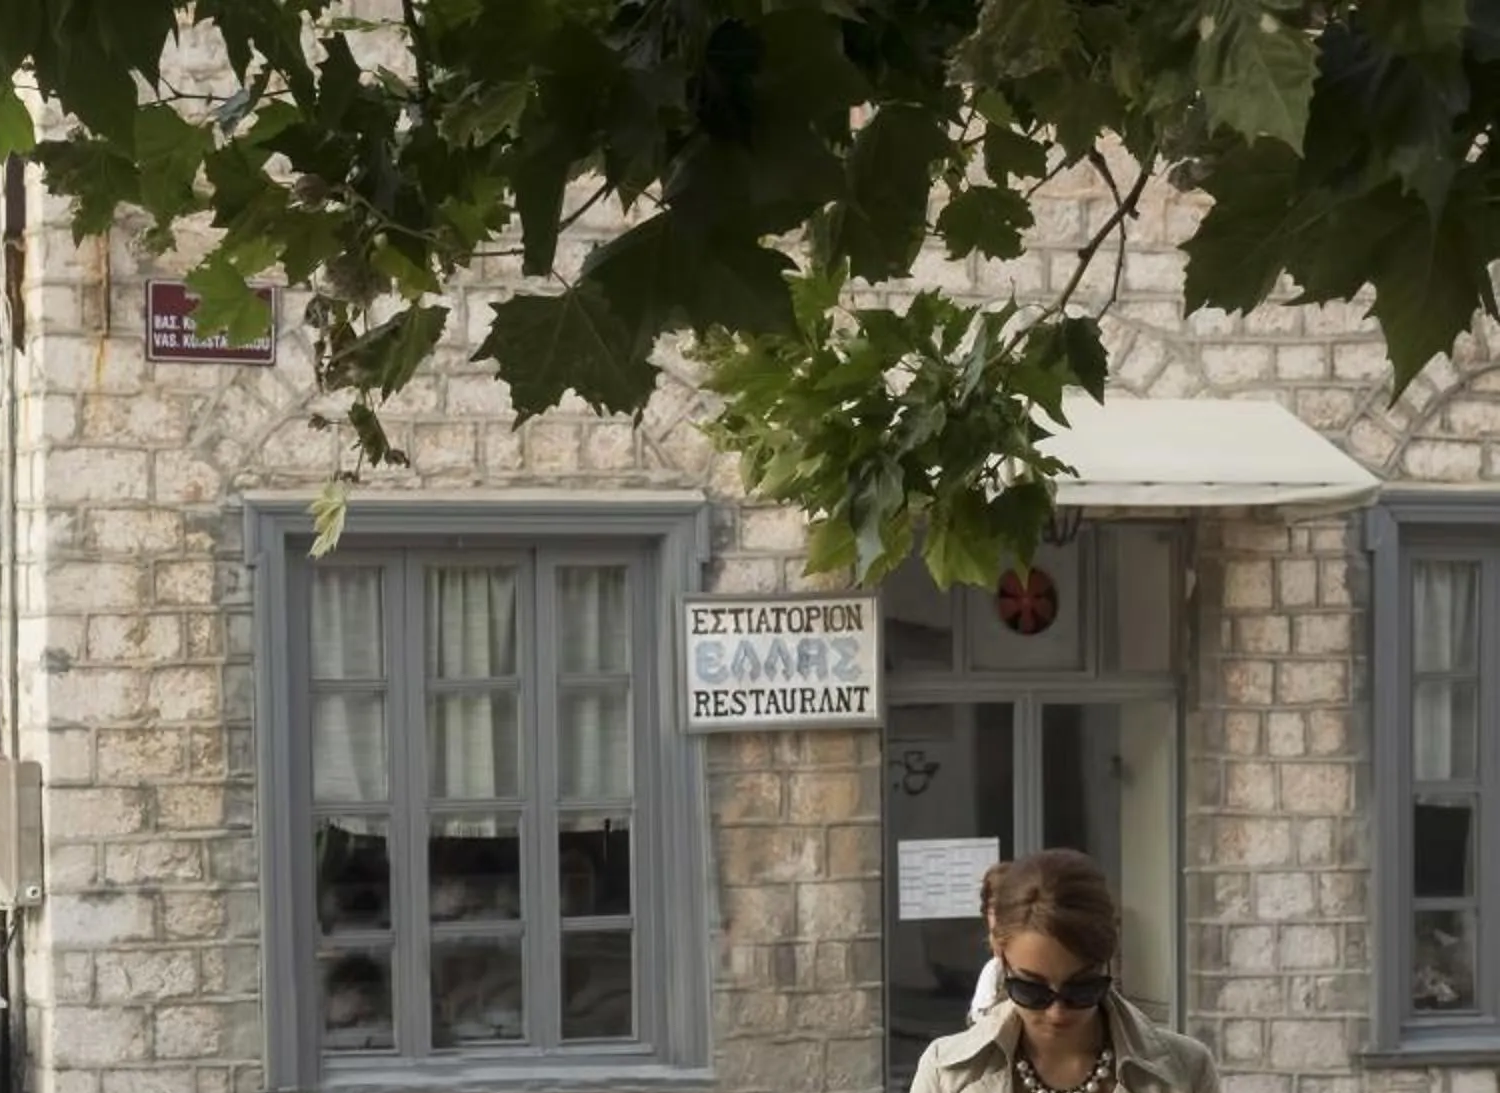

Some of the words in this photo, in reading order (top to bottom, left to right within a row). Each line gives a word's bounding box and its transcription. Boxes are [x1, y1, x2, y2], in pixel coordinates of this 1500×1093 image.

[692, 604, 863, 635] ΕΣΤΙΑΤΟΡΙΟΝ
[694, 637, 862, 684] ΕΛΛΑΣ
[694, 686, 870, 717] RESTAURANT
